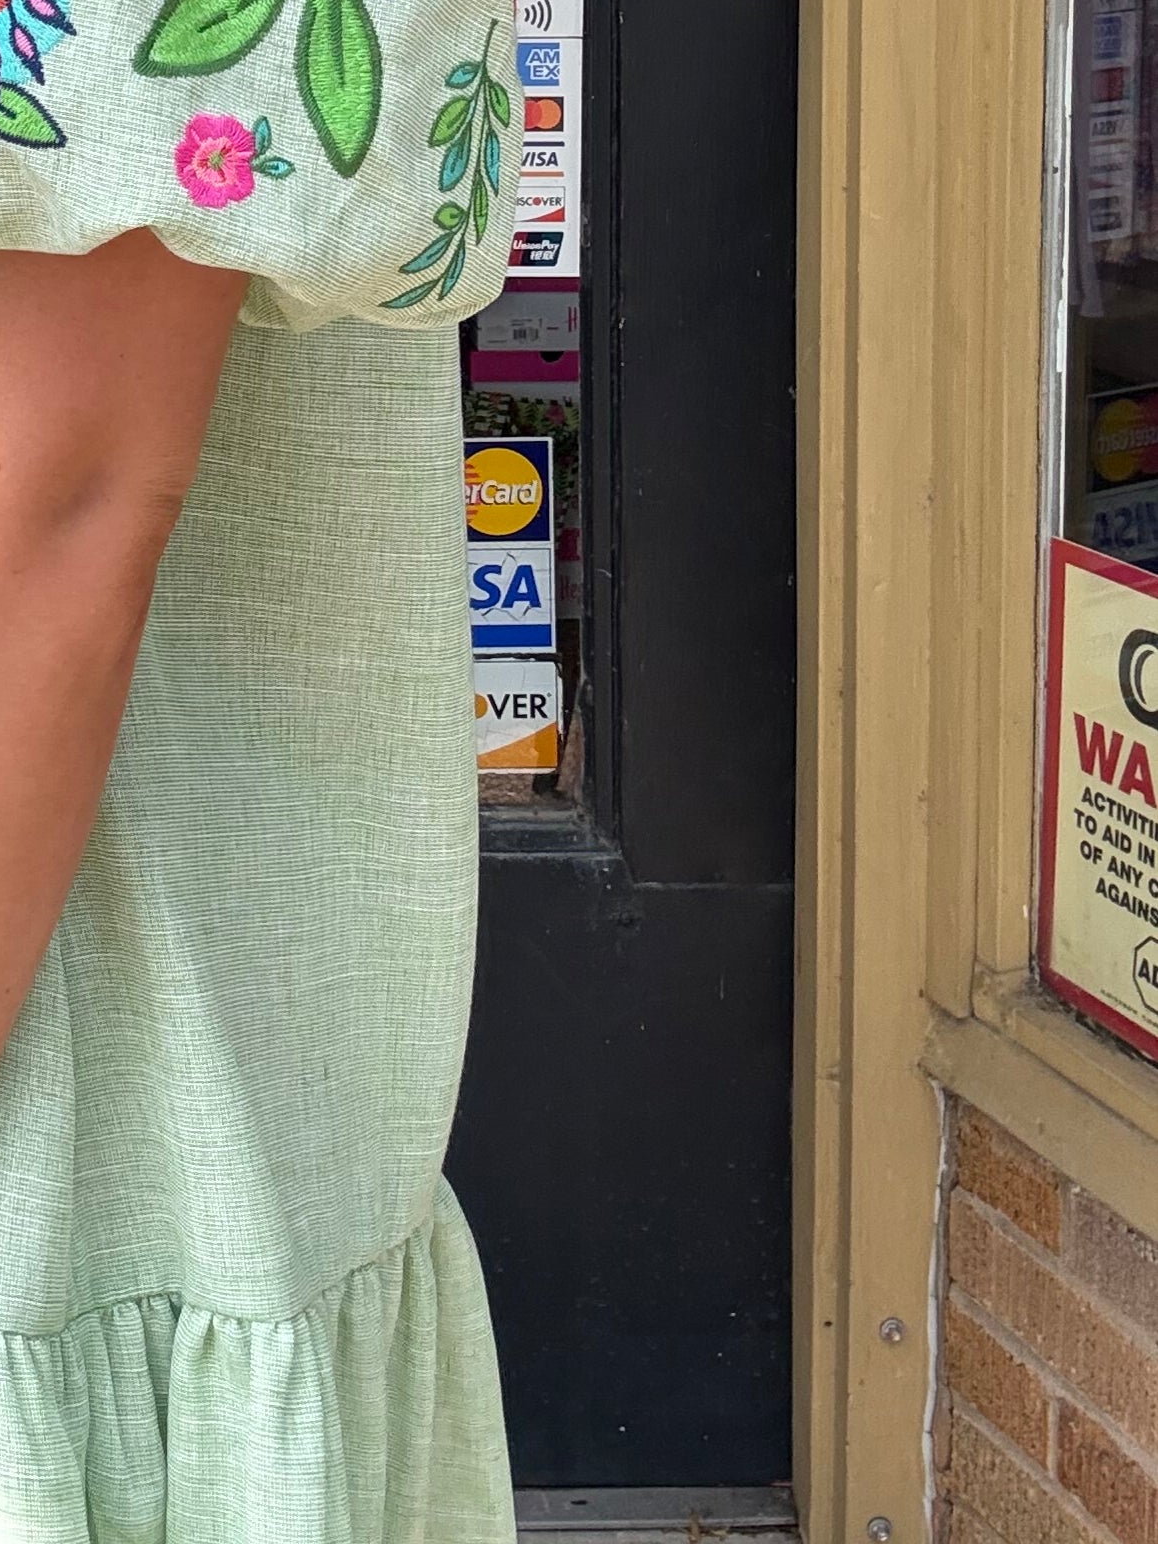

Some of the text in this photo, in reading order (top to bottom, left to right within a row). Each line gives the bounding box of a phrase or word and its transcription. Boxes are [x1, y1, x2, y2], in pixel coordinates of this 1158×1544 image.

[1073, 711, 1157, 809] WA
[1074, 807, 1155, 868] TO AID IN
[1080, 840, 1102, 864] OF
[1107, 856, 1143, 888] ANY
[1095, 877, 1158, 928] AGAINS
